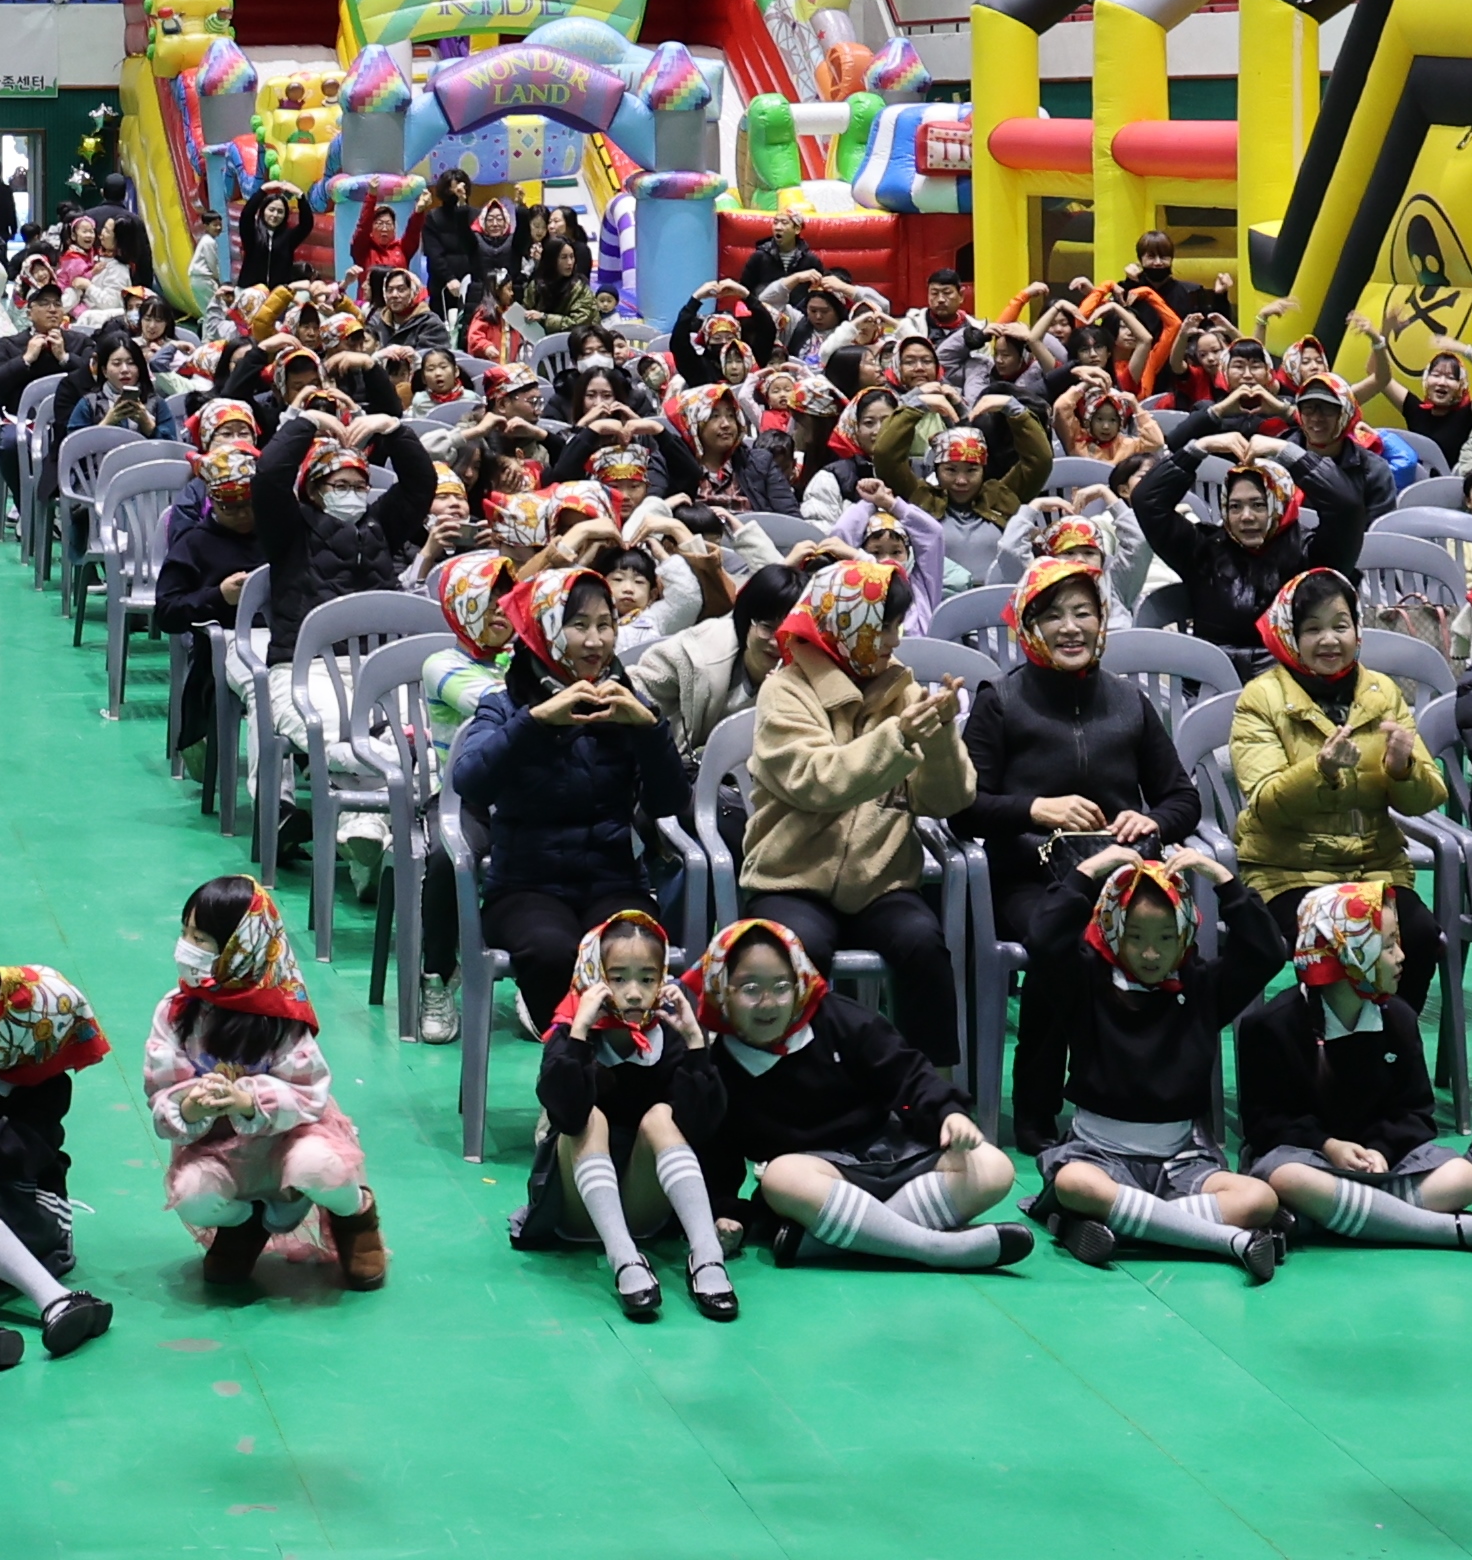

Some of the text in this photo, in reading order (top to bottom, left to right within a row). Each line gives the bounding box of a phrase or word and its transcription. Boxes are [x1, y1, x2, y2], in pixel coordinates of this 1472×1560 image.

[464, 51, 590, 93] WONDER
[493, 83, 573, 106] LAND
[935, 137, 972, 162] TI
